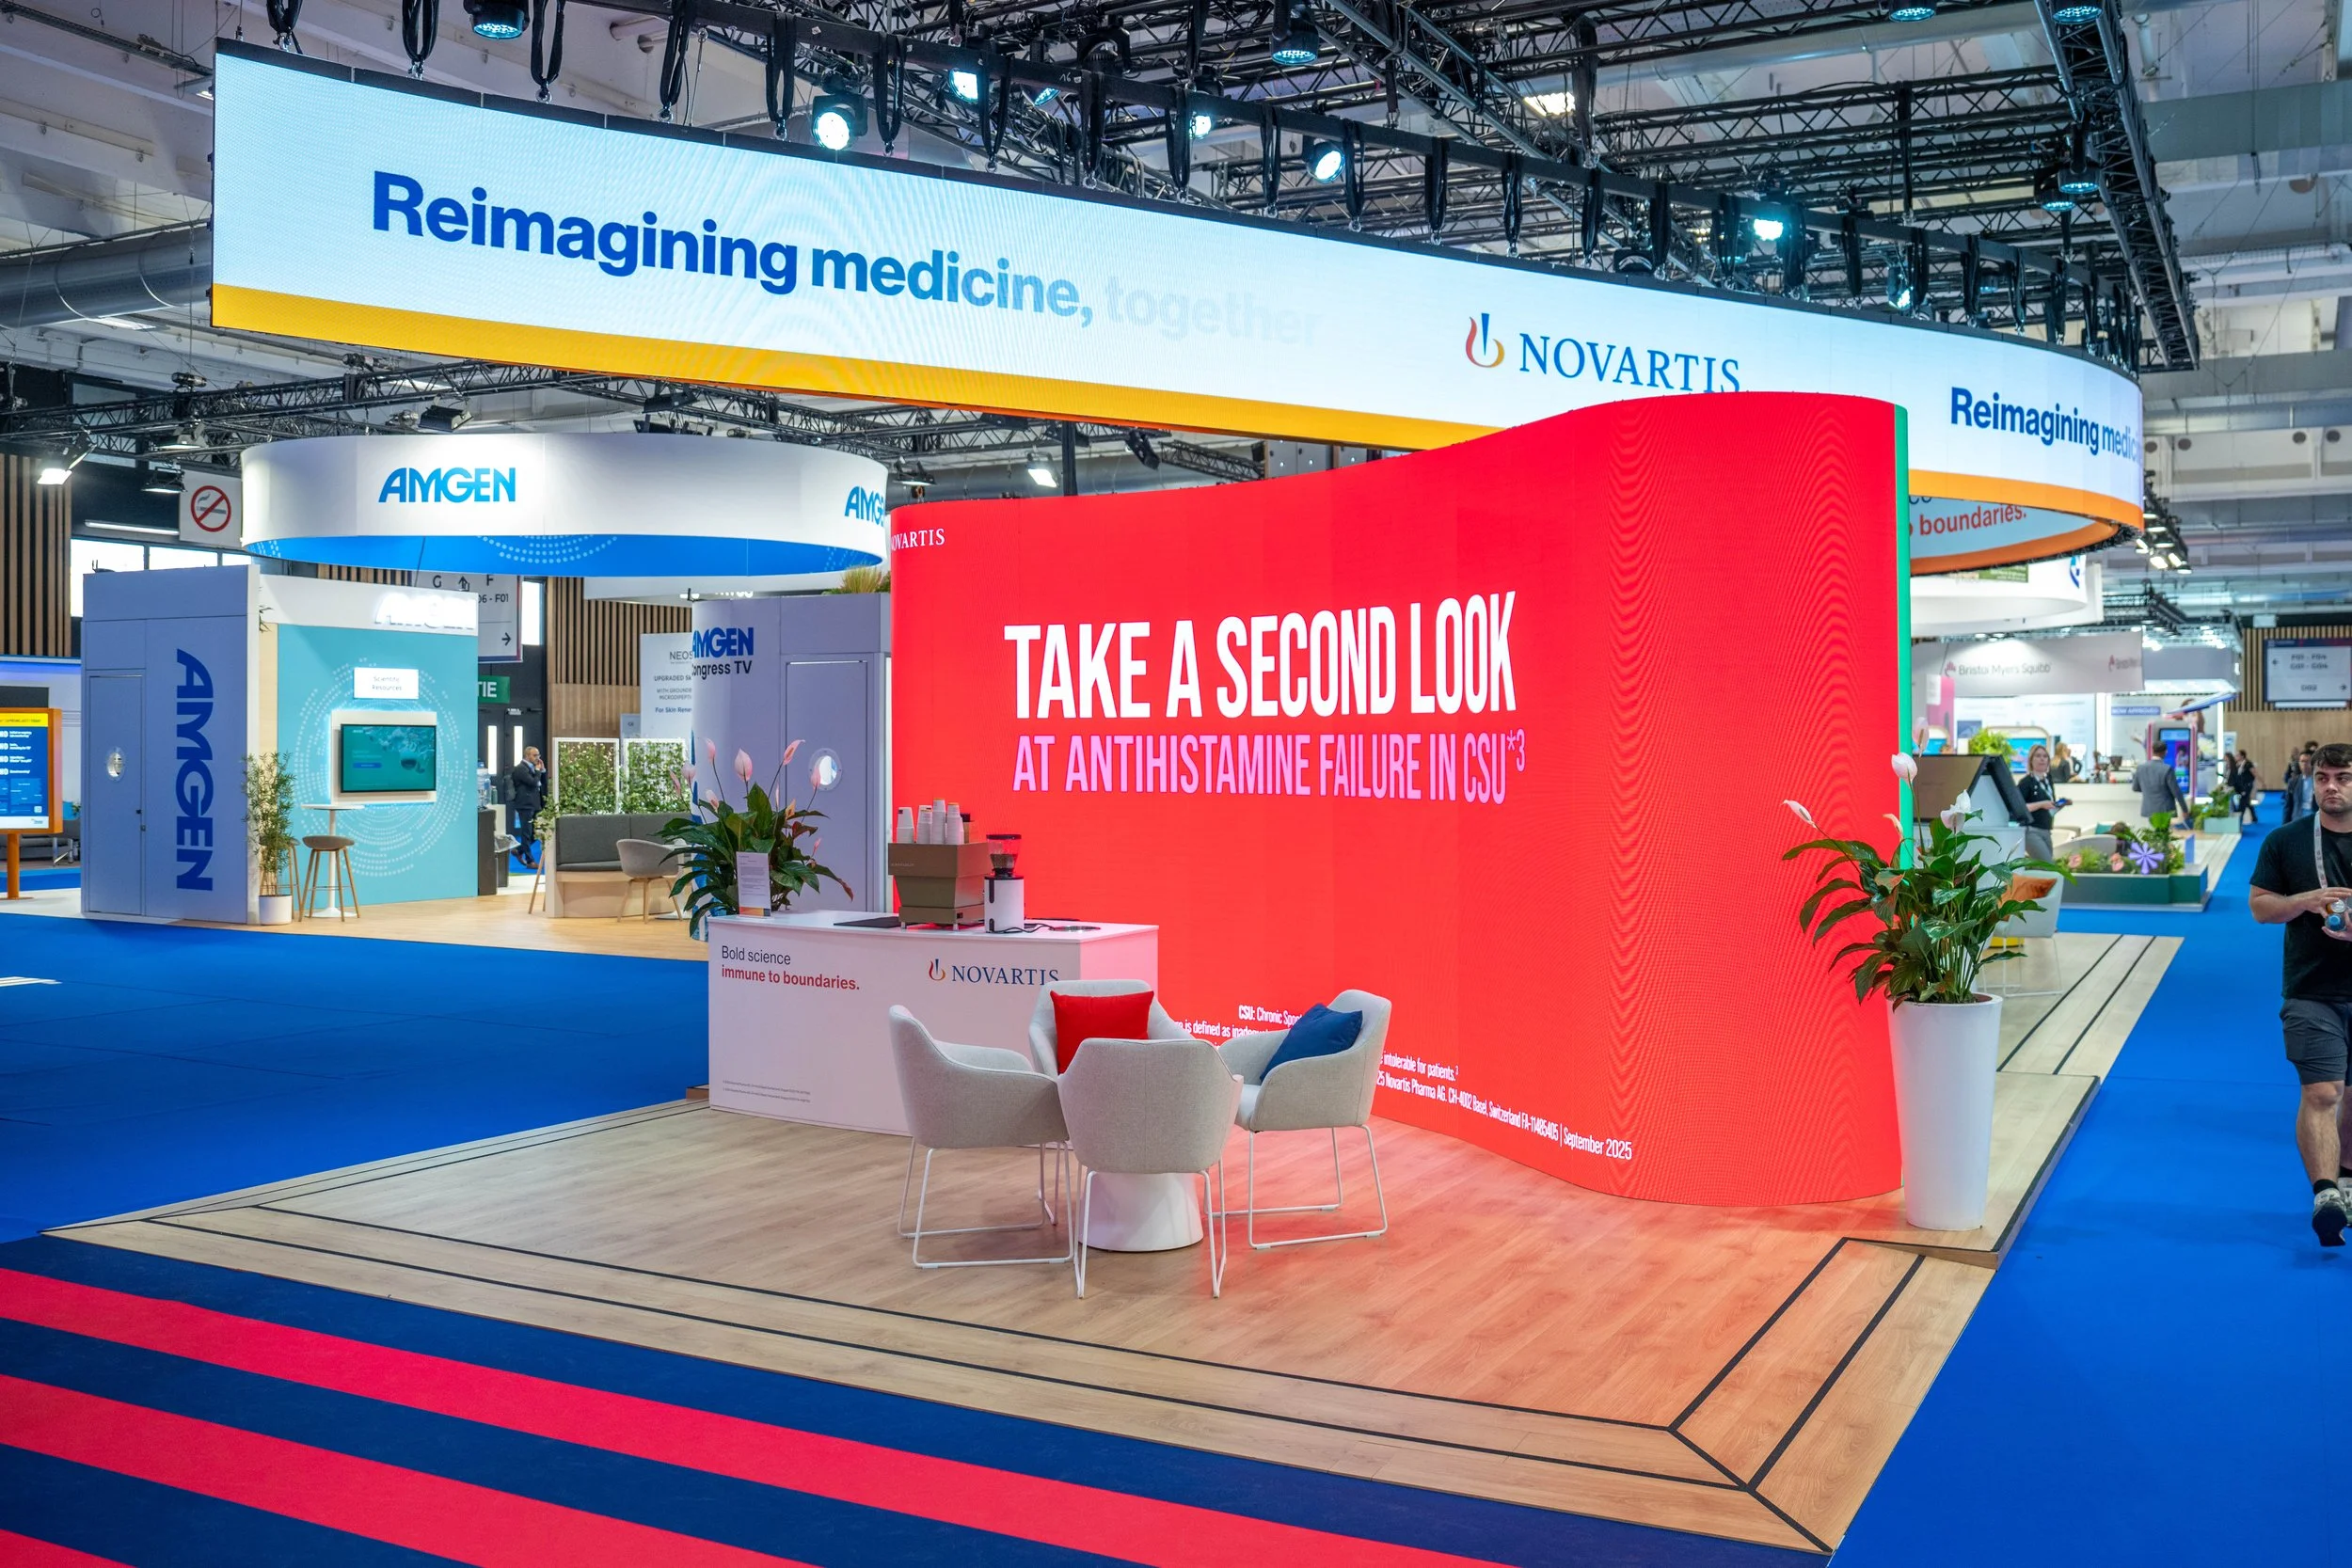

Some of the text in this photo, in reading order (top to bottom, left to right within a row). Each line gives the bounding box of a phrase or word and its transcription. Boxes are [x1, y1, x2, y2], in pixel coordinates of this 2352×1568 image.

[373, 170, 799, 295] Reimagining
[811, 249, 1093, 327] medicine,
[1519, 332, 1740, 393] NOVARTIS
[1951, 387, 2099, 456] Reimagining
[378, 467, 516, 503] AMGEN
[844, 485, 884, 527] AMG
[1919, 504, 2026, 536] boundaries.
[432, 575, 442, 588] G
[486, 574, 494, 586] F
[495, 594, 509, 603] F01
[734, 660, 753, 674] TV
[1004, 591, 1517, 719] TAKE A SECOND LOOK
[1958, 664, 1990, 675] Bristol
[2022, 662, 2051, 675] Squibb
[176, 649, 214, 892] AMGEN
[1013, 736, 1056, 792] AT
[1066, 735, 1311, 796] ANTIHISTAMINE
[1320, 734, 1422, 800] FAILURE
[1429, 733, 1456, 801] IN
[722, 945, 791, 966] Bold science
[722, 965, 860, 990] immune to boundaries.
[951, 965, 1058, 986] NOVARTIS
[1238, 1005, 1256, 1020] CSU:
[1256, 1006, 1282, 1024] Chronic
[1193, 1021, 1221, 1037] defined
[1221, 1026, 1232, 1037] as
[1383, 1051, 1417, 1072] intolerable
[1417, 1057, 1427, 1074] for
[1385, 1072, 1411, 1093] Novartis
[1411, 1078, 1437, 1100] Pharma
[1437, 1085, 1447, 1102] AG.
[1448, 1087, 1472, 1110] CH-4002
[1472, 1095, 1488, 1117] Basel,
[1488, 1101, 1520, 1129] Switzerland
[1563, 1127, 1604, 1155] September
[1605, 1138, 1632, 1160] 2025
